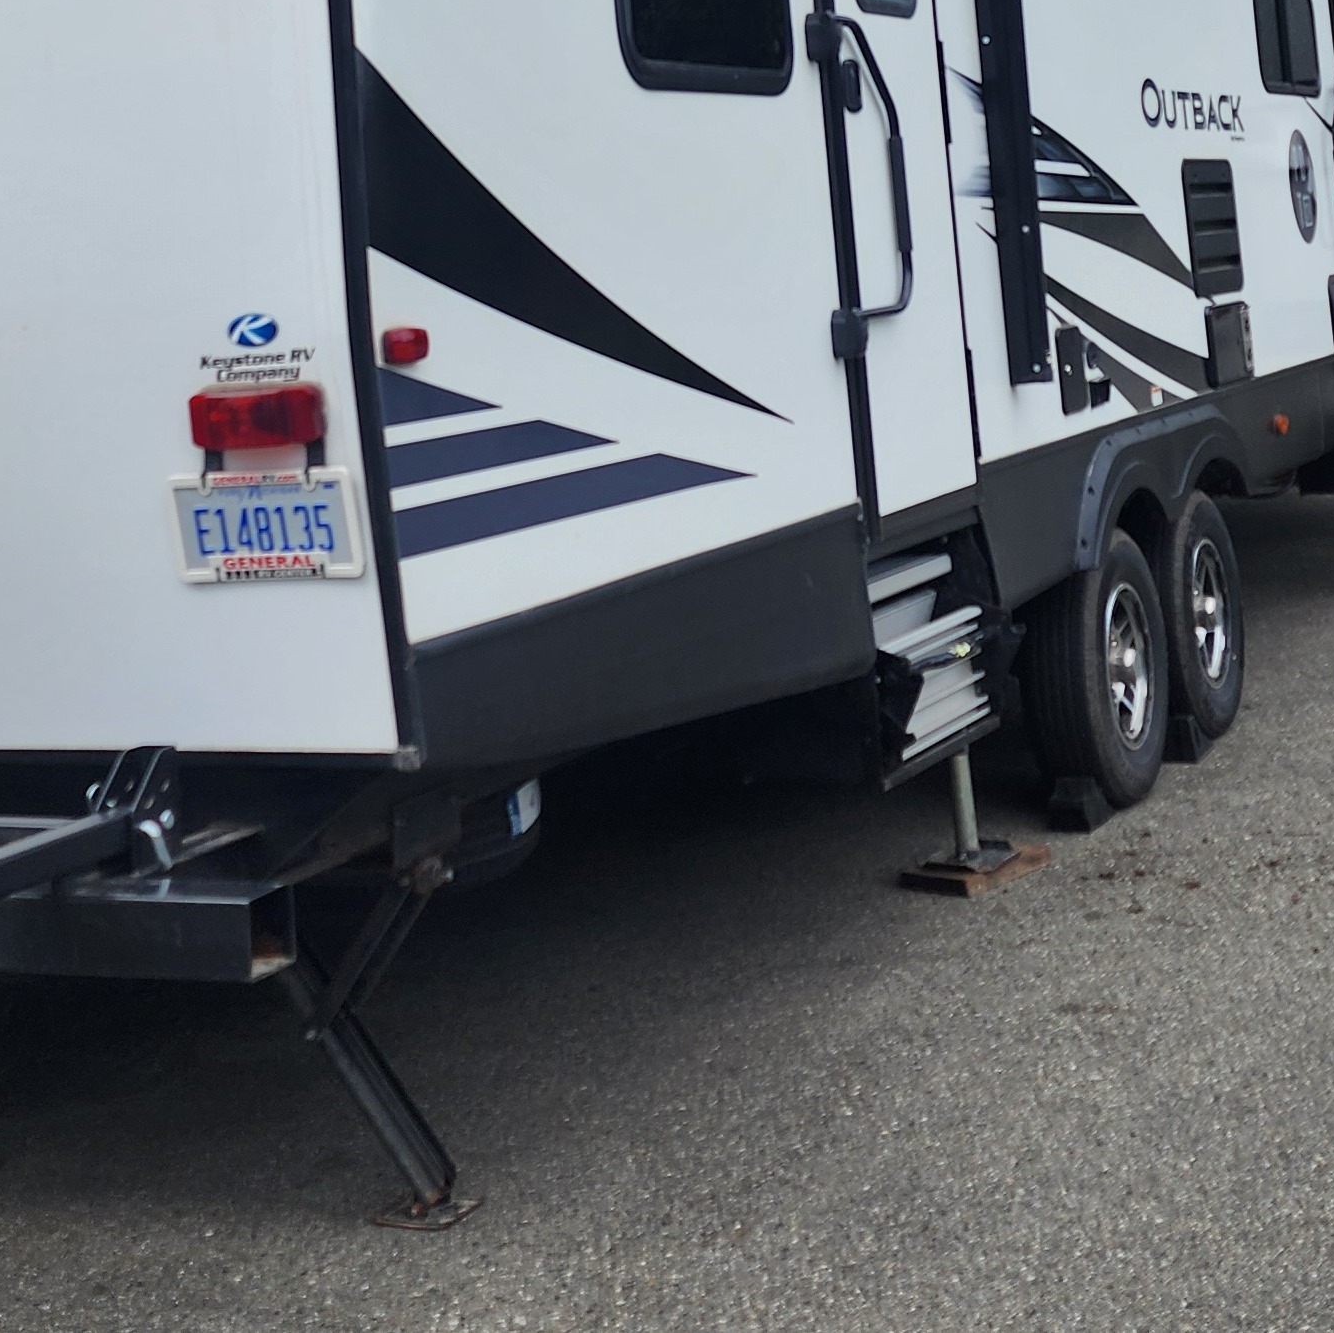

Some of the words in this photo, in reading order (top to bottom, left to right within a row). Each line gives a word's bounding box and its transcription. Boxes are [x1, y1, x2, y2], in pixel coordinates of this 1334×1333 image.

[1141, 78, 1245, 133] OUTBACK
[200, 353, 286, 370] Keystone
[290, 347, 316, 363] RV
[216, 366, 301, 383] Company
[193, 504, 335, 555] E148135
[223, 555, 316, 570] GENERAL
